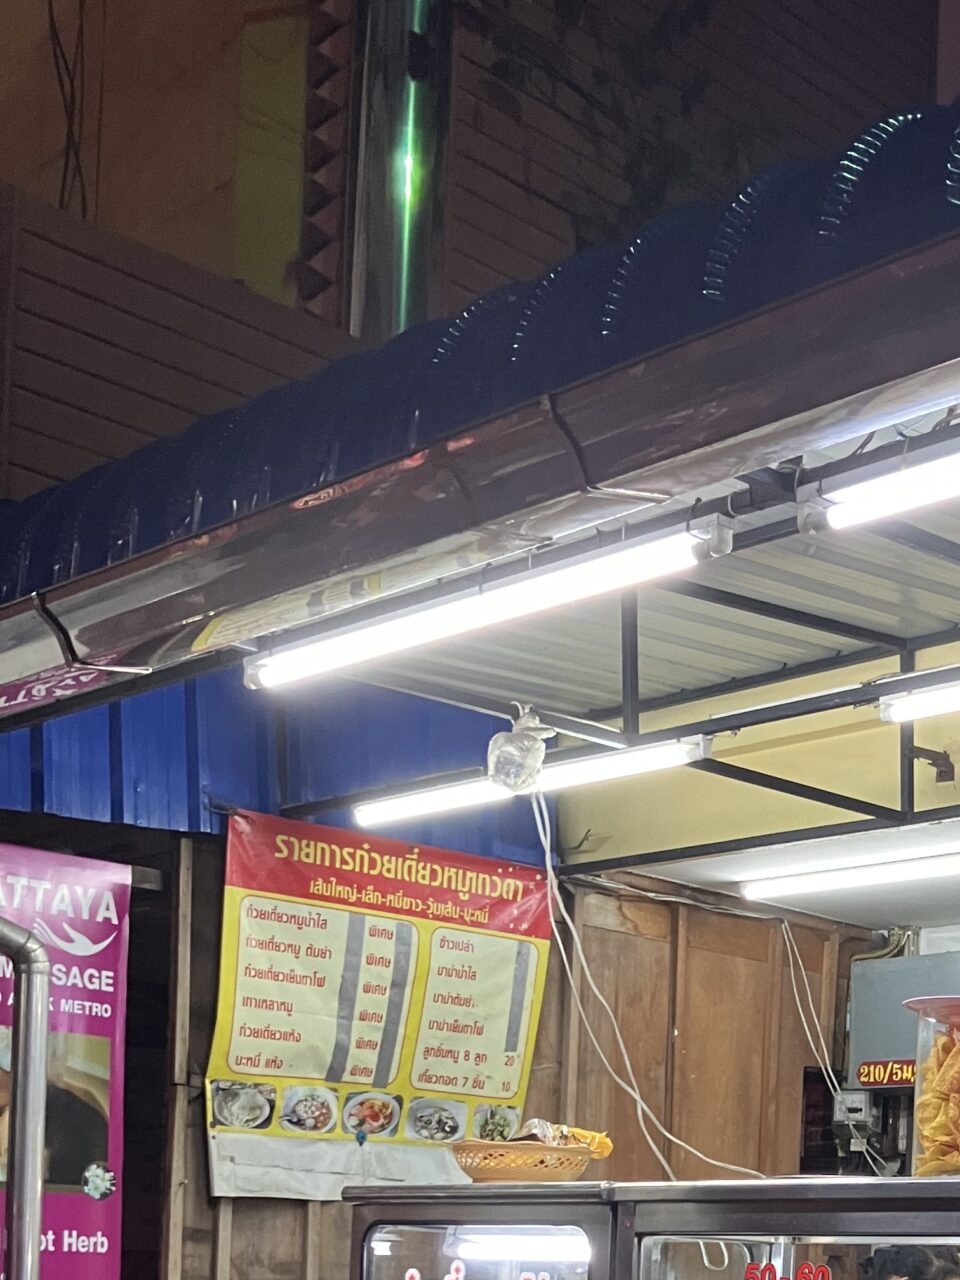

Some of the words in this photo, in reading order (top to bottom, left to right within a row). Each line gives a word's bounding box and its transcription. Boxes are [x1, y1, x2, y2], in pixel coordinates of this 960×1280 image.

[60, 999, 112, 1018] METRO
[463, 1050, 470, 1062] 8
[504, 1055, 515, 1067] 20
[462, 1076, 469, 1087] 7
[501, 1081, 511, 1092] 10
[62, 1230, 109, 1254] Herb
